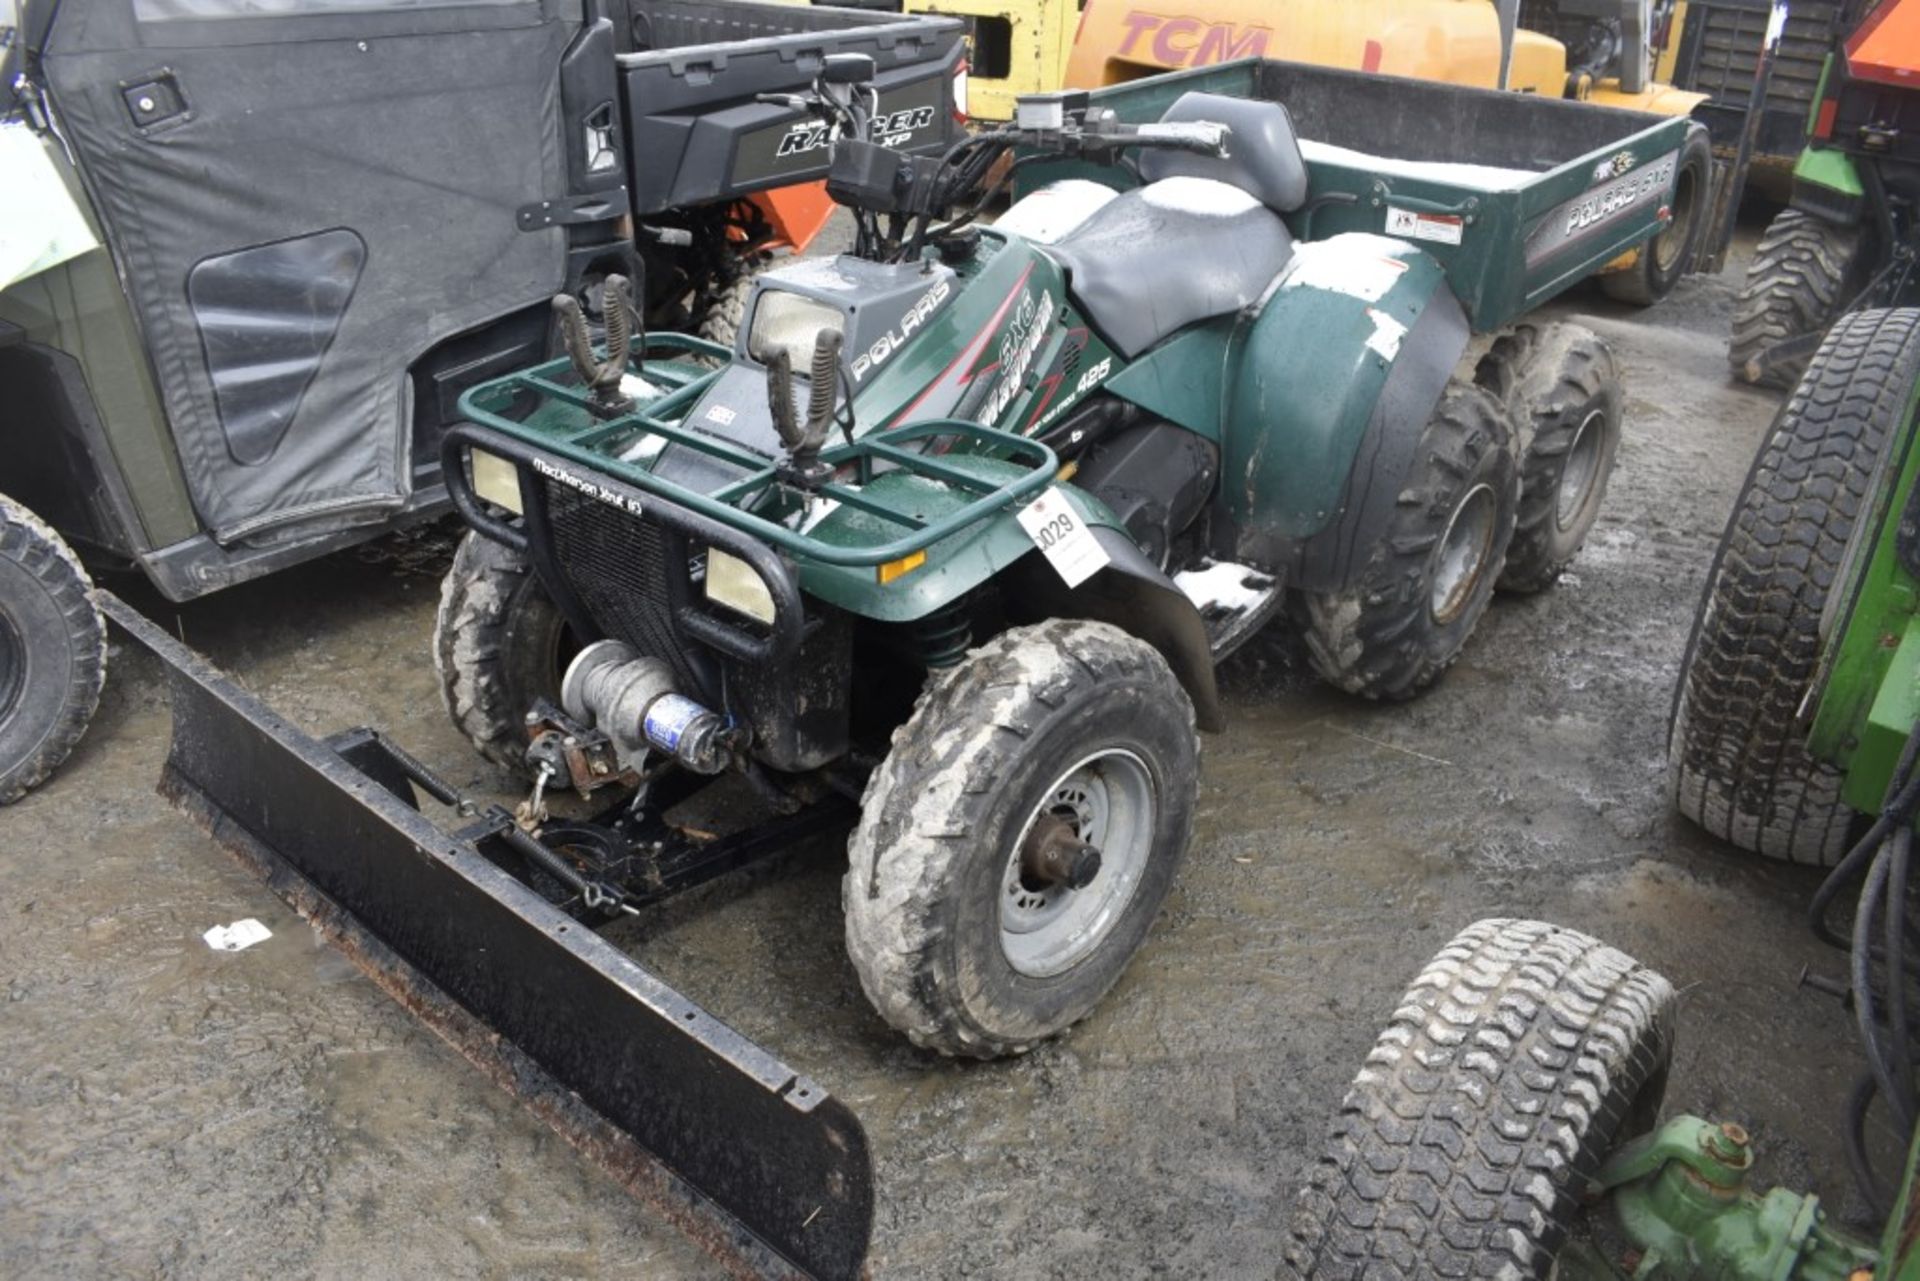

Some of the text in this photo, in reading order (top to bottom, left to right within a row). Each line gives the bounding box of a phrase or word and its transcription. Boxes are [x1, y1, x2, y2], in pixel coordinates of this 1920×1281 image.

[1120, 11, 1272, 68] TCM
[881, 132, 912, 147] XP
[1565, 178, 1638, 237] POLARIS
[851, 274, 950, 382] POLARIS
[1077, 357, 1112, 393] 425
